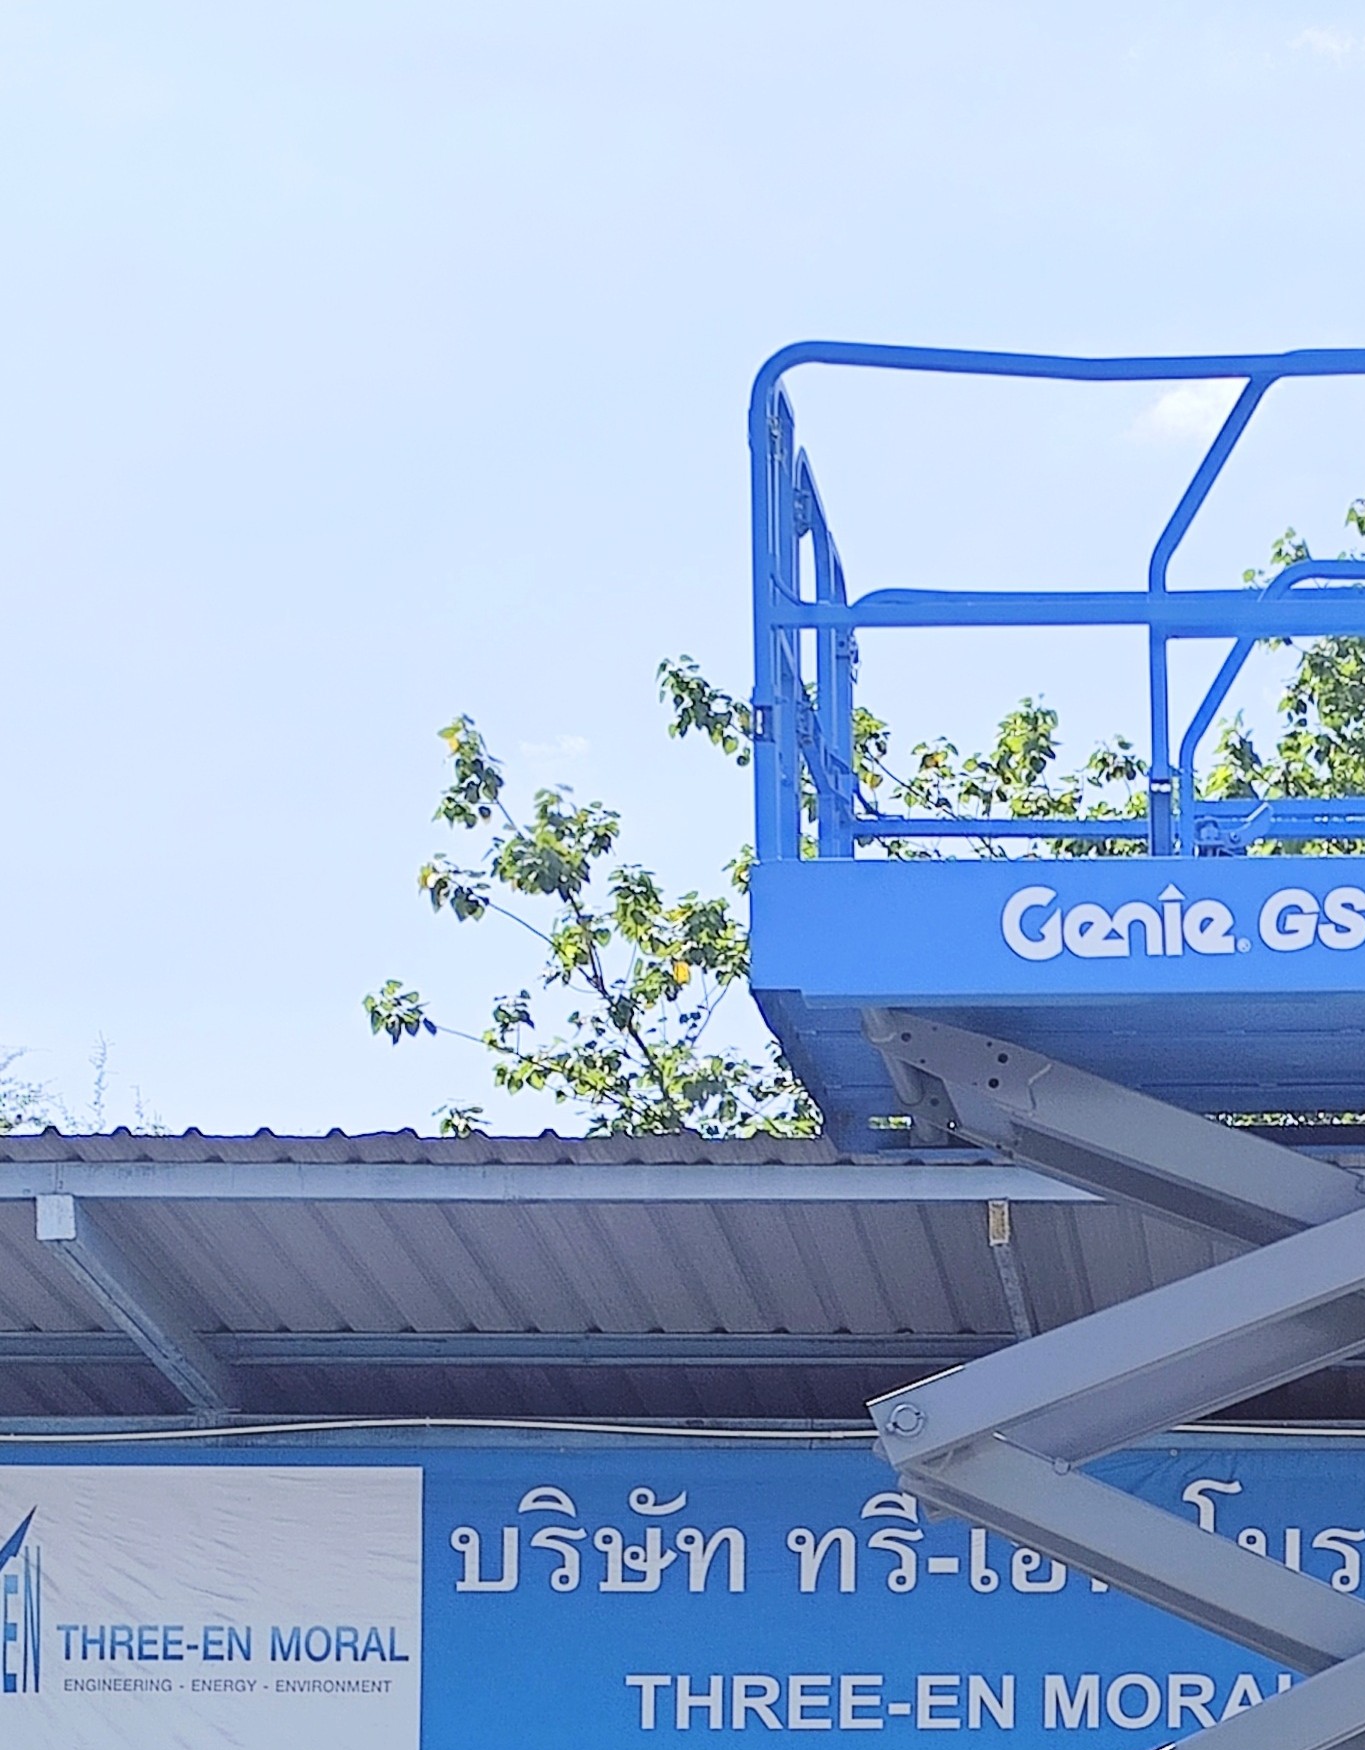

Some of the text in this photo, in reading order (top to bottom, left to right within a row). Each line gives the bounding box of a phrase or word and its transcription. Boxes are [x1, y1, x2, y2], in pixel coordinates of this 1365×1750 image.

[450, 1486, 747, 1594] บริษัท
[57, 1625, 410, 1662] THREE-EN MORAL
[64, 1679, 173, 1693] ENGINEERING
[191, 1680, 257, 1693] ENERGY
[275, 1680, 393, 1694] ENVIRONMENT
[625, 1674, 1015, 1730] THREE-EN
